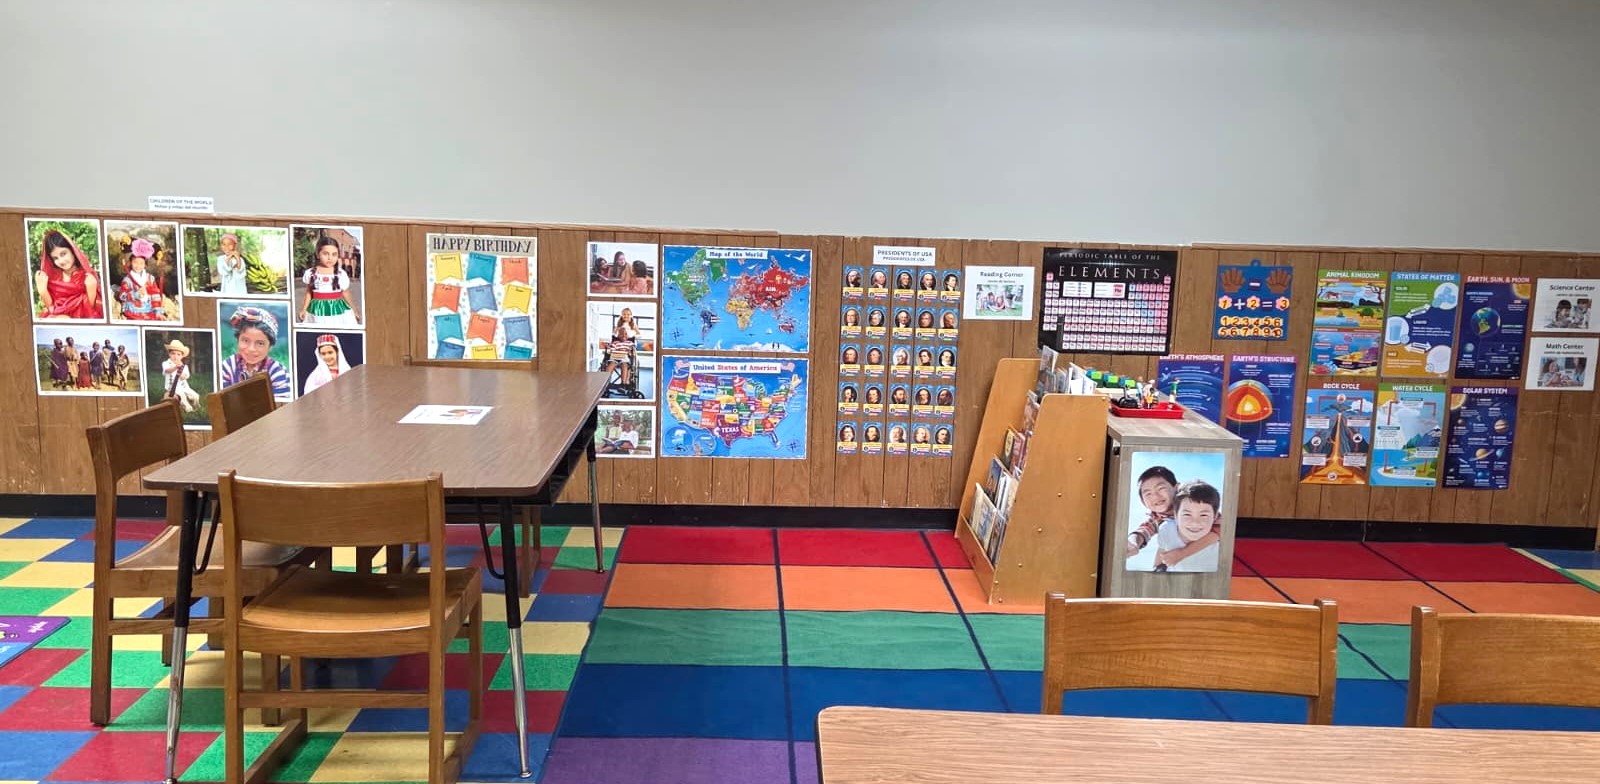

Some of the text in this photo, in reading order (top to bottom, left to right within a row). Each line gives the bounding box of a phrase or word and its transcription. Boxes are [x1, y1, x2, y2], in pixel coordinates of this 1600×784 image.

[433, 238, 531, 253] HAPPY BIRTHDAY
[1058, 266, 1160, 279] ELEMENTS
[1222, 300, 1228, 308] 1
[1250, 300, 1256, 308] 2
[1280, 300, 1287, 309] 3
[1232, 318, 1239, 326] 2
